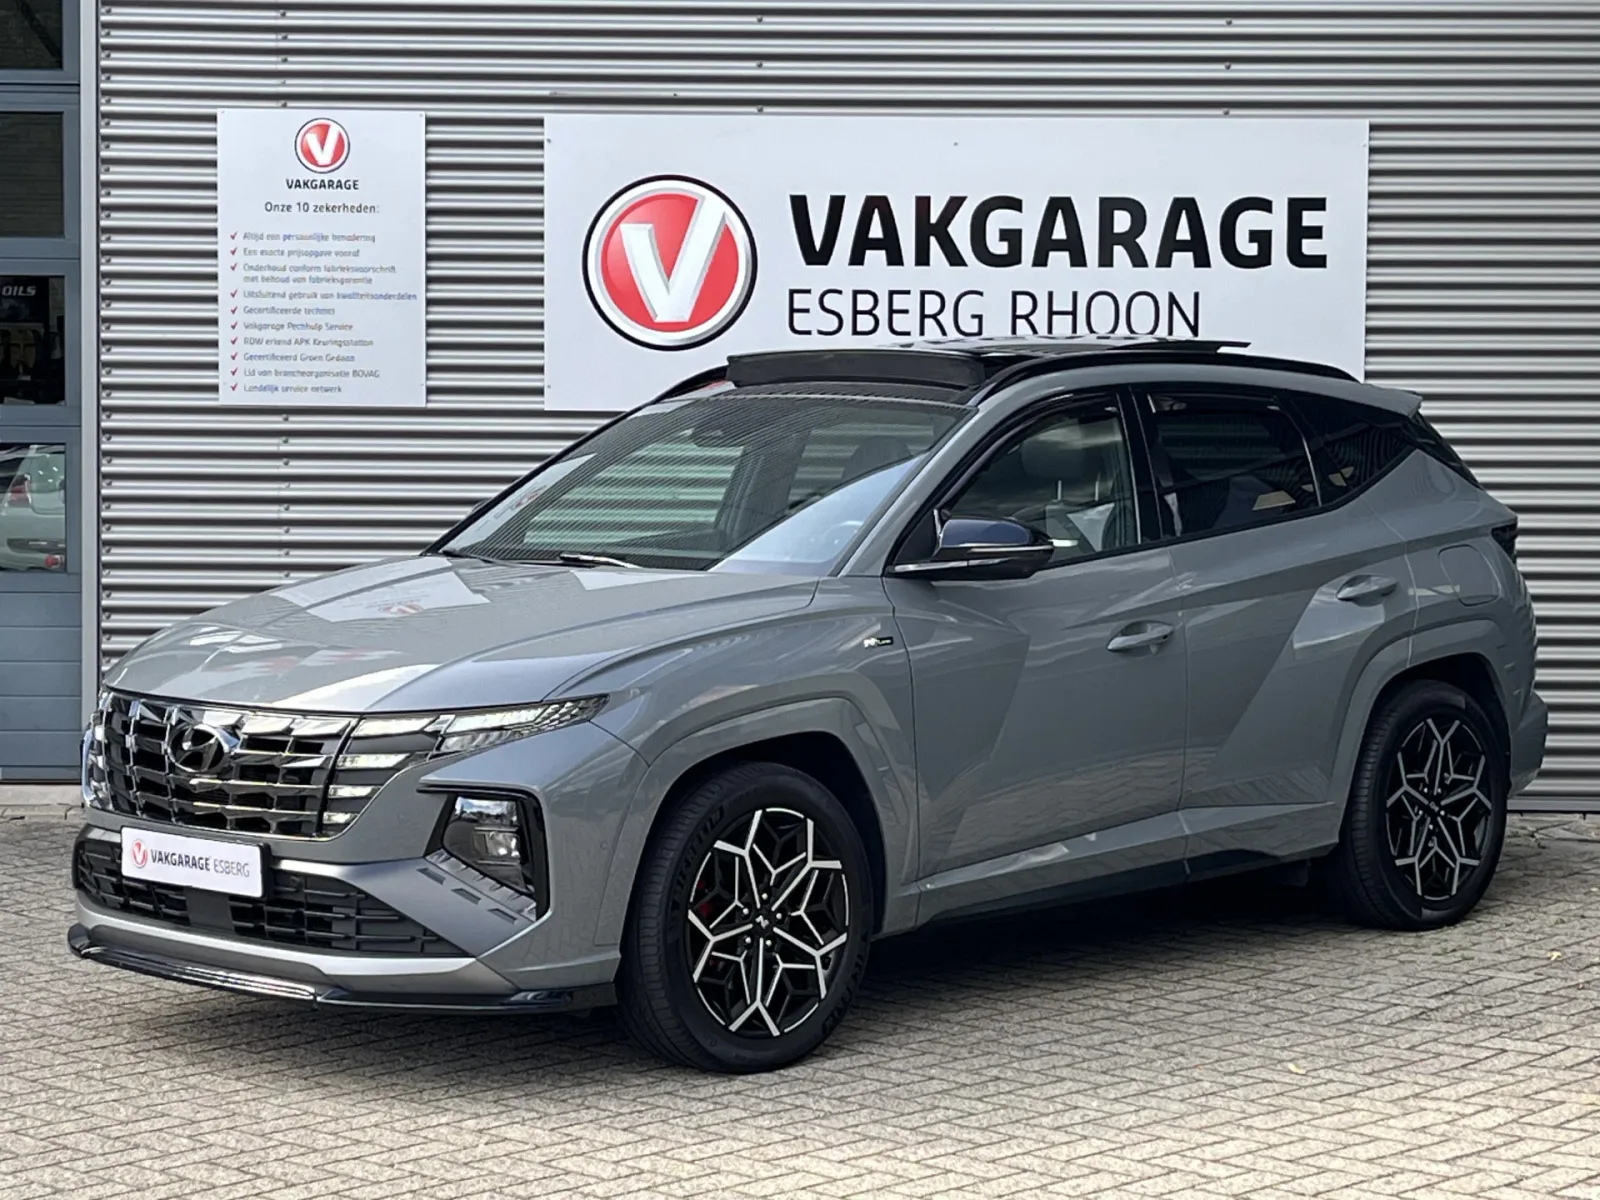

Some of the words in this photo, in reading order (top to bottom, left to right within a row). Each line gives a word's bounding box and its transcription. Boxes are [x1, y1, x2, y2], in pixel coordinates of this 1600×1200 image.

[285, 179, 360, 190] VAKGARAGE
[264, 201, 292, 212] Onze
[296, 202, 309, 212] 10
[313, 203, 380, 214] zekerheden:
[789, 194, 1327, 269] VAKGARAGE
[2, 286, 36, 296] OILS
[788, 289, 985, 337] ESBERG
[1010, 291, 1201, 338] RHOON
[150, 849, 211, 871] VAKGARAGE
[213, 858, 251, 878] ESBERG
